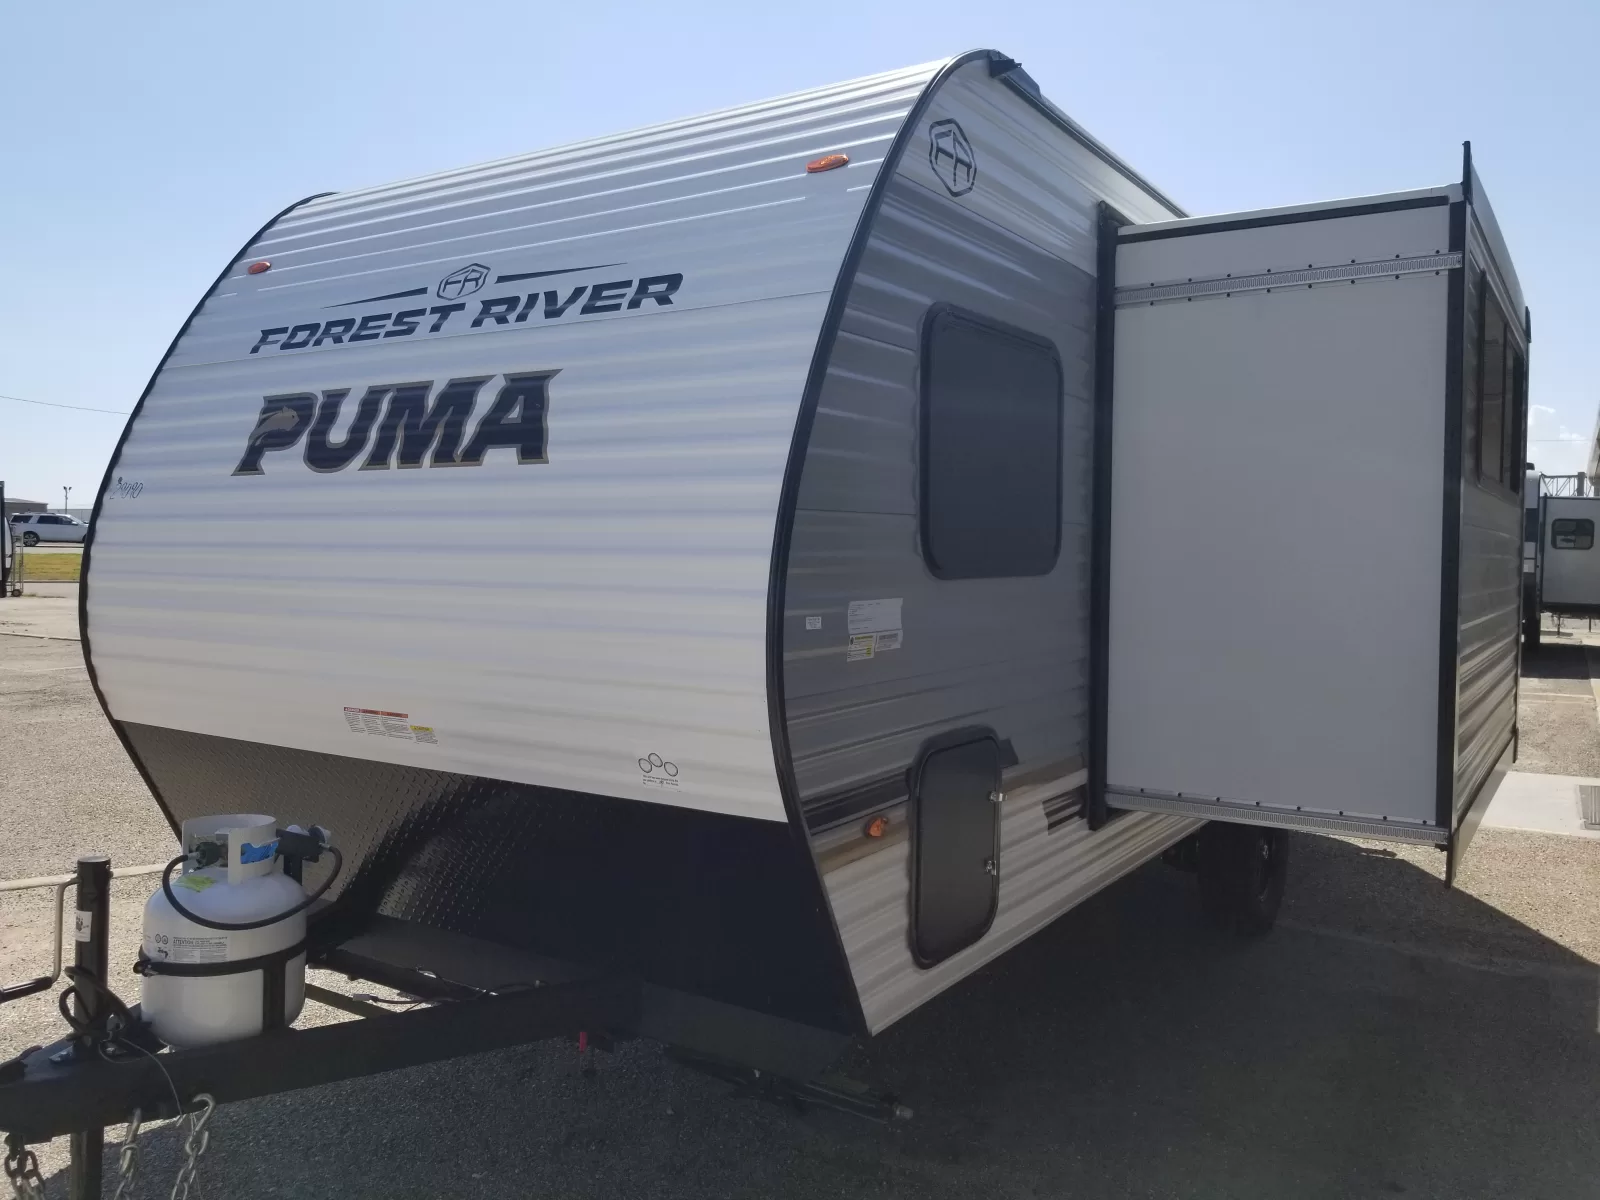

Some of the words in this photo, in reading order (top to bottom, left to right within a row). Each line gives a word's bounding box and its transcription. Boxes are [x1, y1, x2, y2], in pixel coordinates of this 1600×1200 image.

[249, 303, 466, 354] FOREST
[470, 273, 684, 328] RIVER
[231, 368, 564, 476] PUMA
